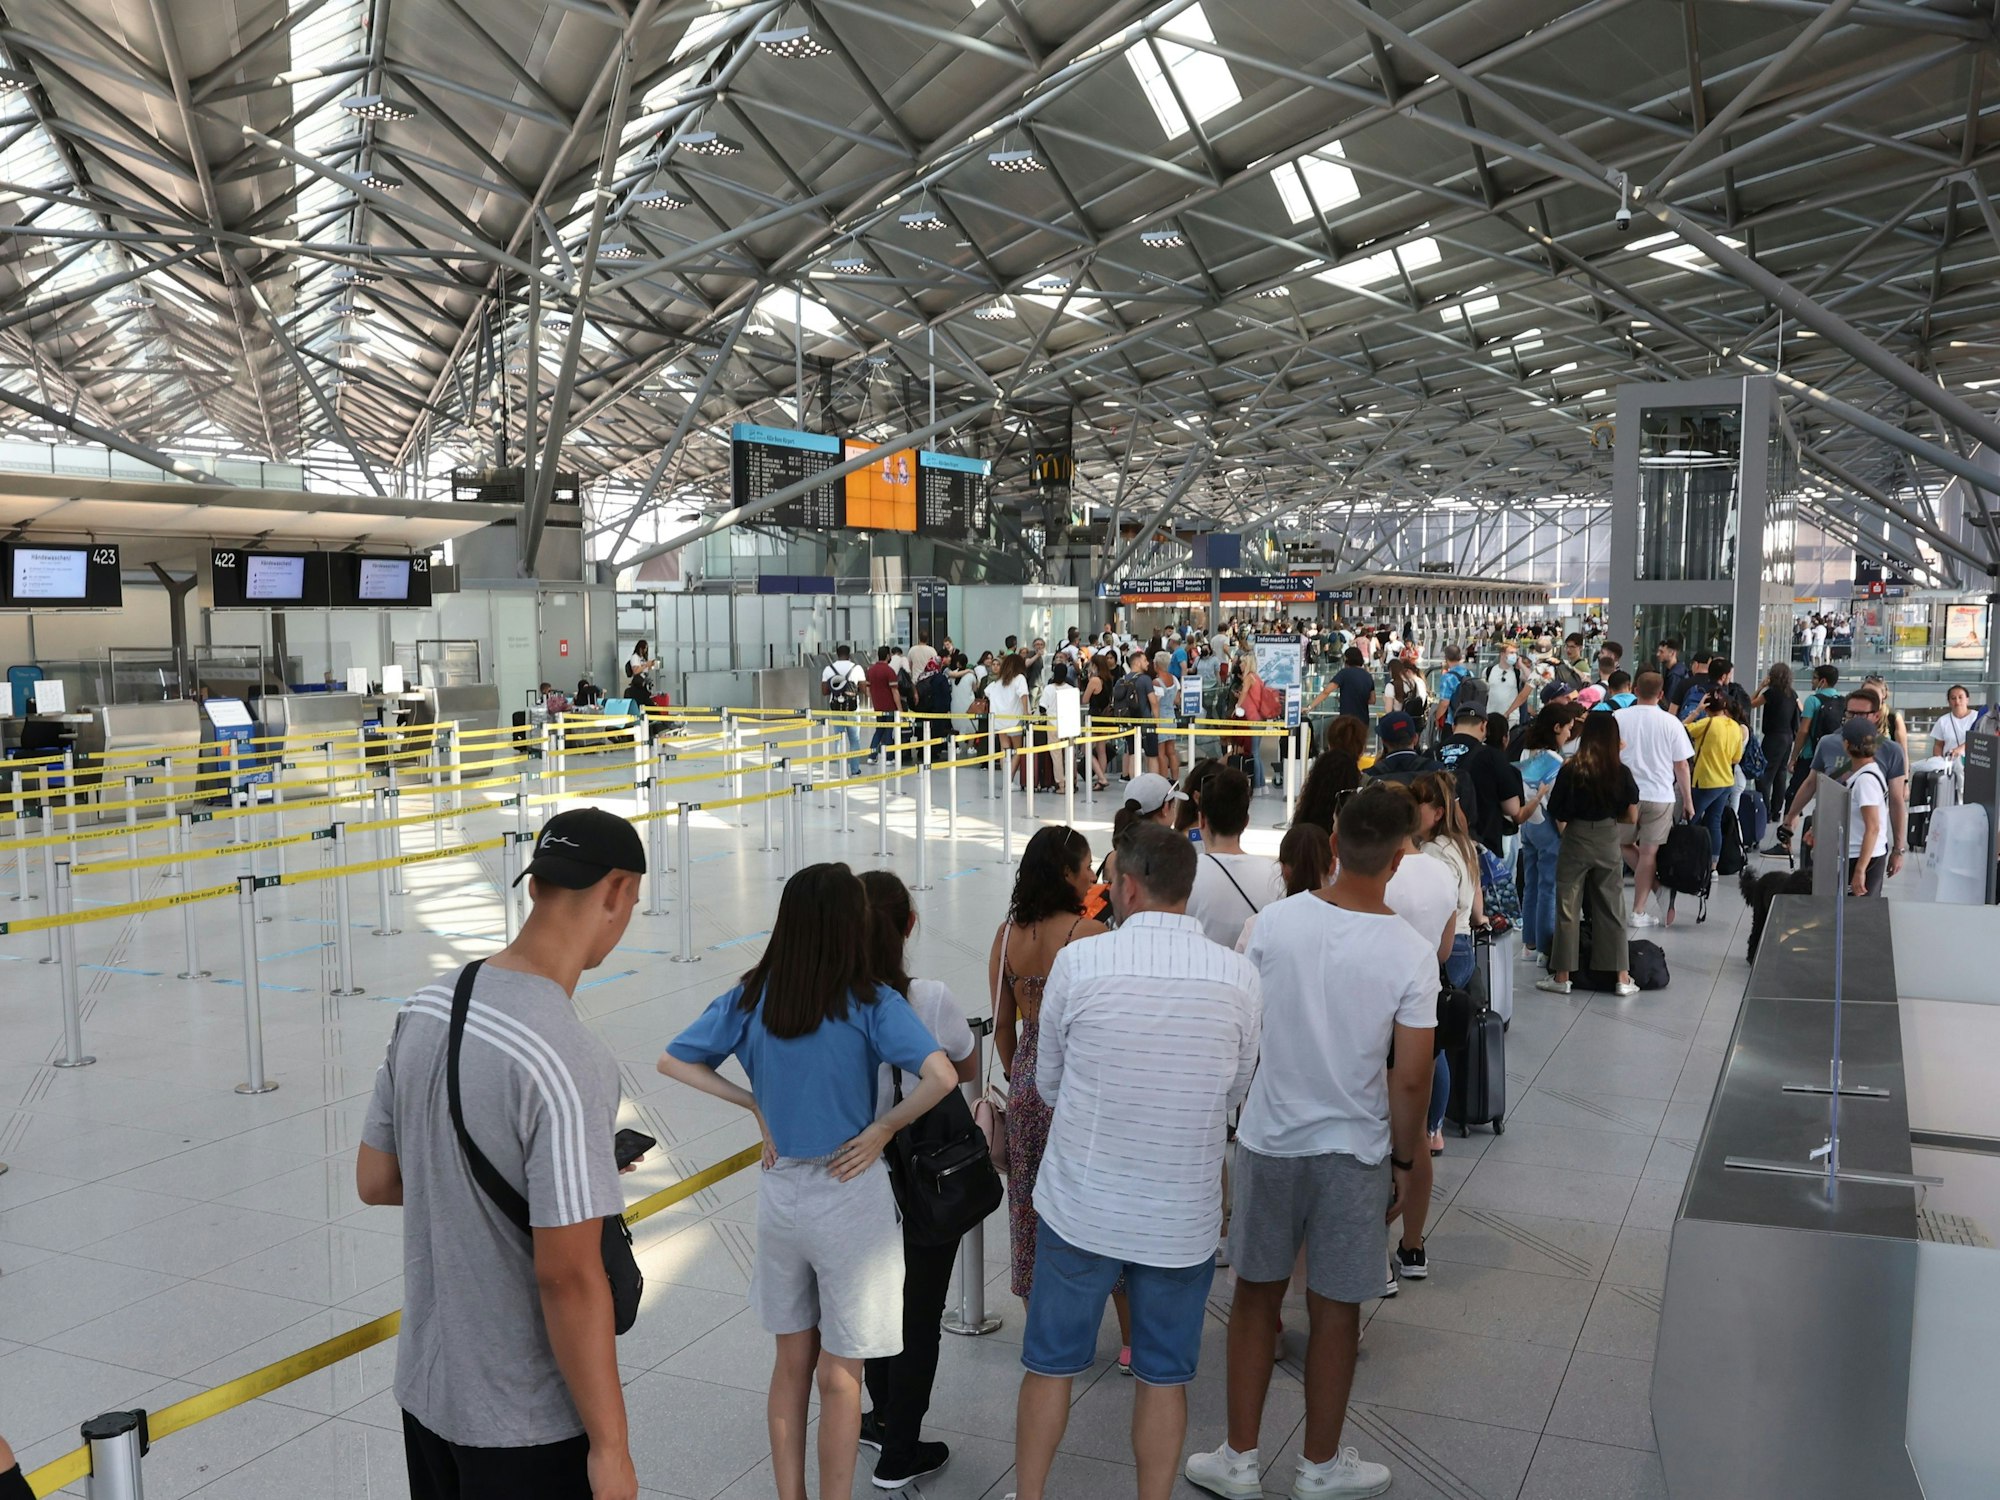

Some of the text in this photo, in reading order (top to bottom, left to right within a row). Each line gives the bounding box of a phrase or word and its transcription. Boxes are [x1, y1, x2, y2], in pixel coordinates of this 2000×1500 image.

[93, 549, 116, 565] 423
[214, 553, 235, 567] 422
[413, 559, 428, 572] 421
